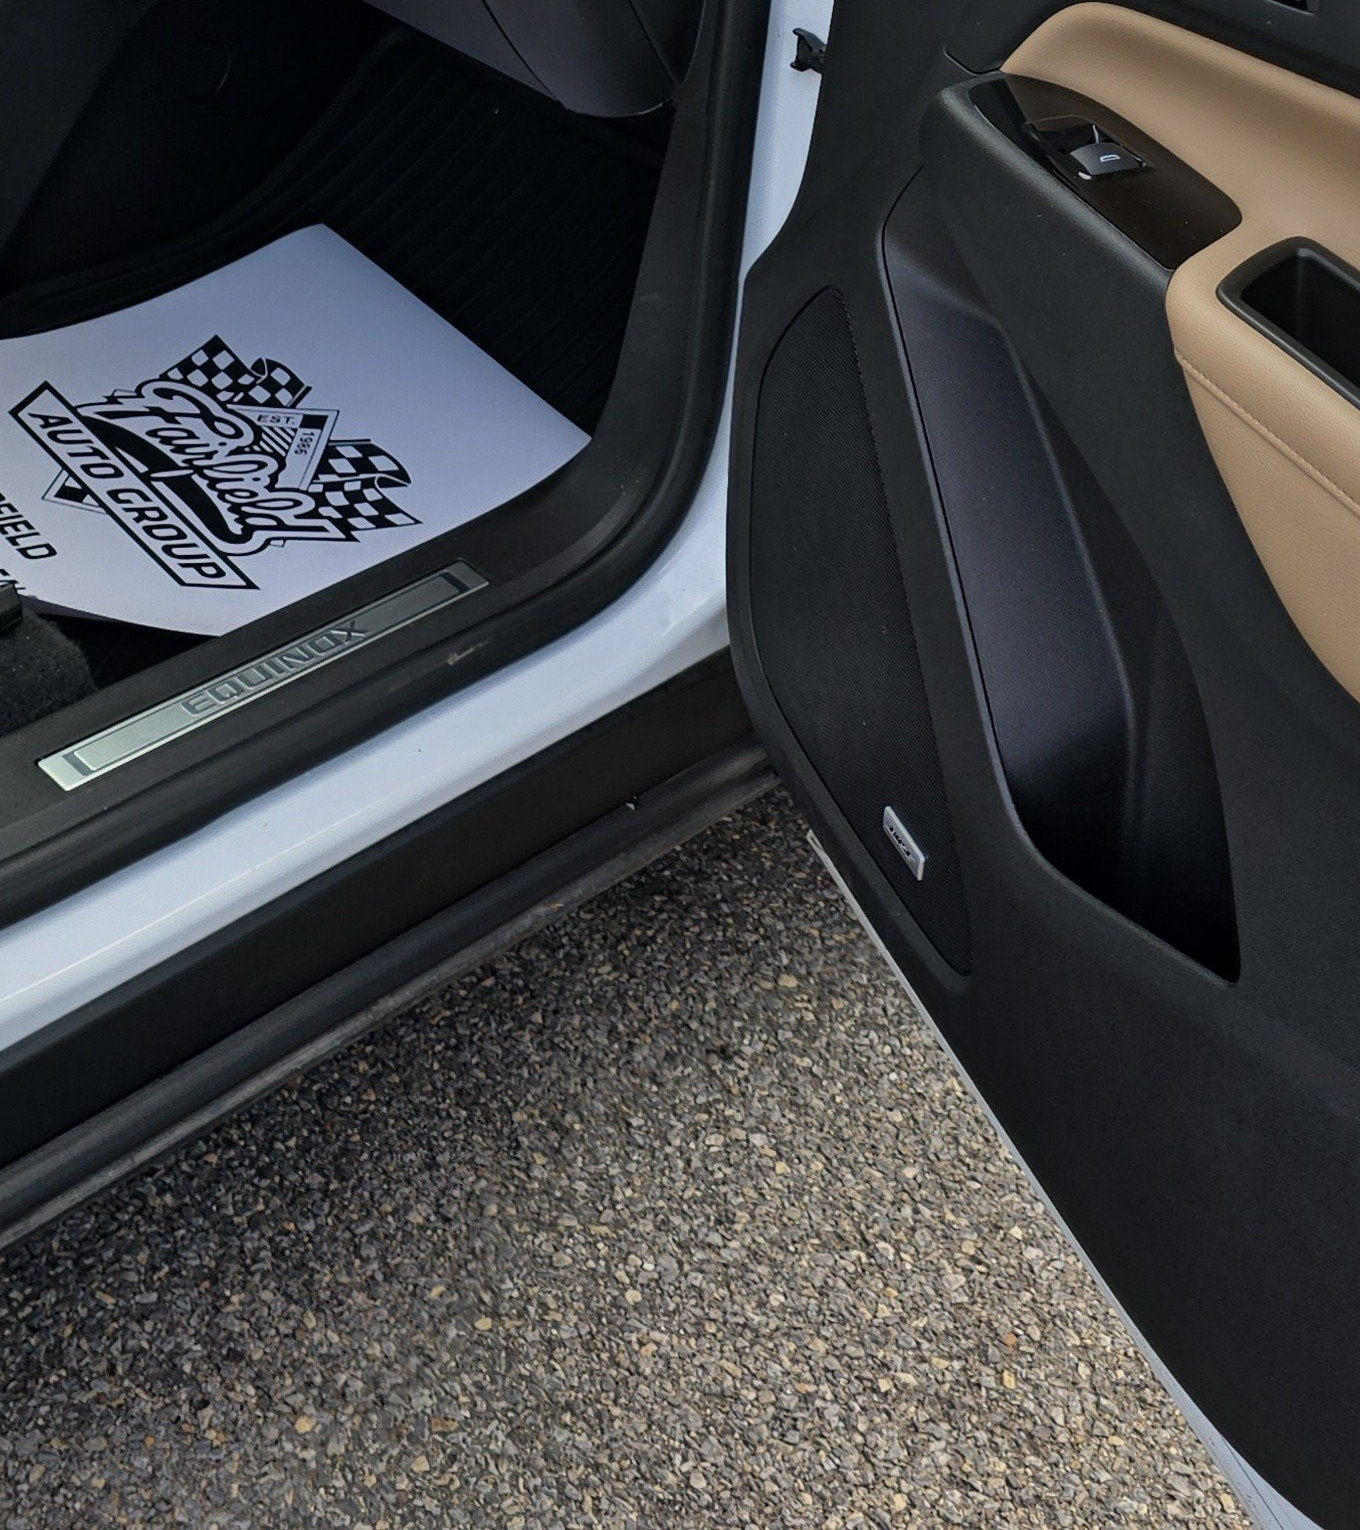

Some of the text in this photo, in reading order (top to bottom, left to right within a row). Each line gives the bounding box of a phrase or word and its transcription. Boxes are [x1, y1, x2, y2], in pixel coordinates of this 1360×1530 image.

[29, 412, 228, 579] AUTO GROUP
[90, 382, 336, 537] Fairfield
[181, 621, 368, 717] EQUINOX
